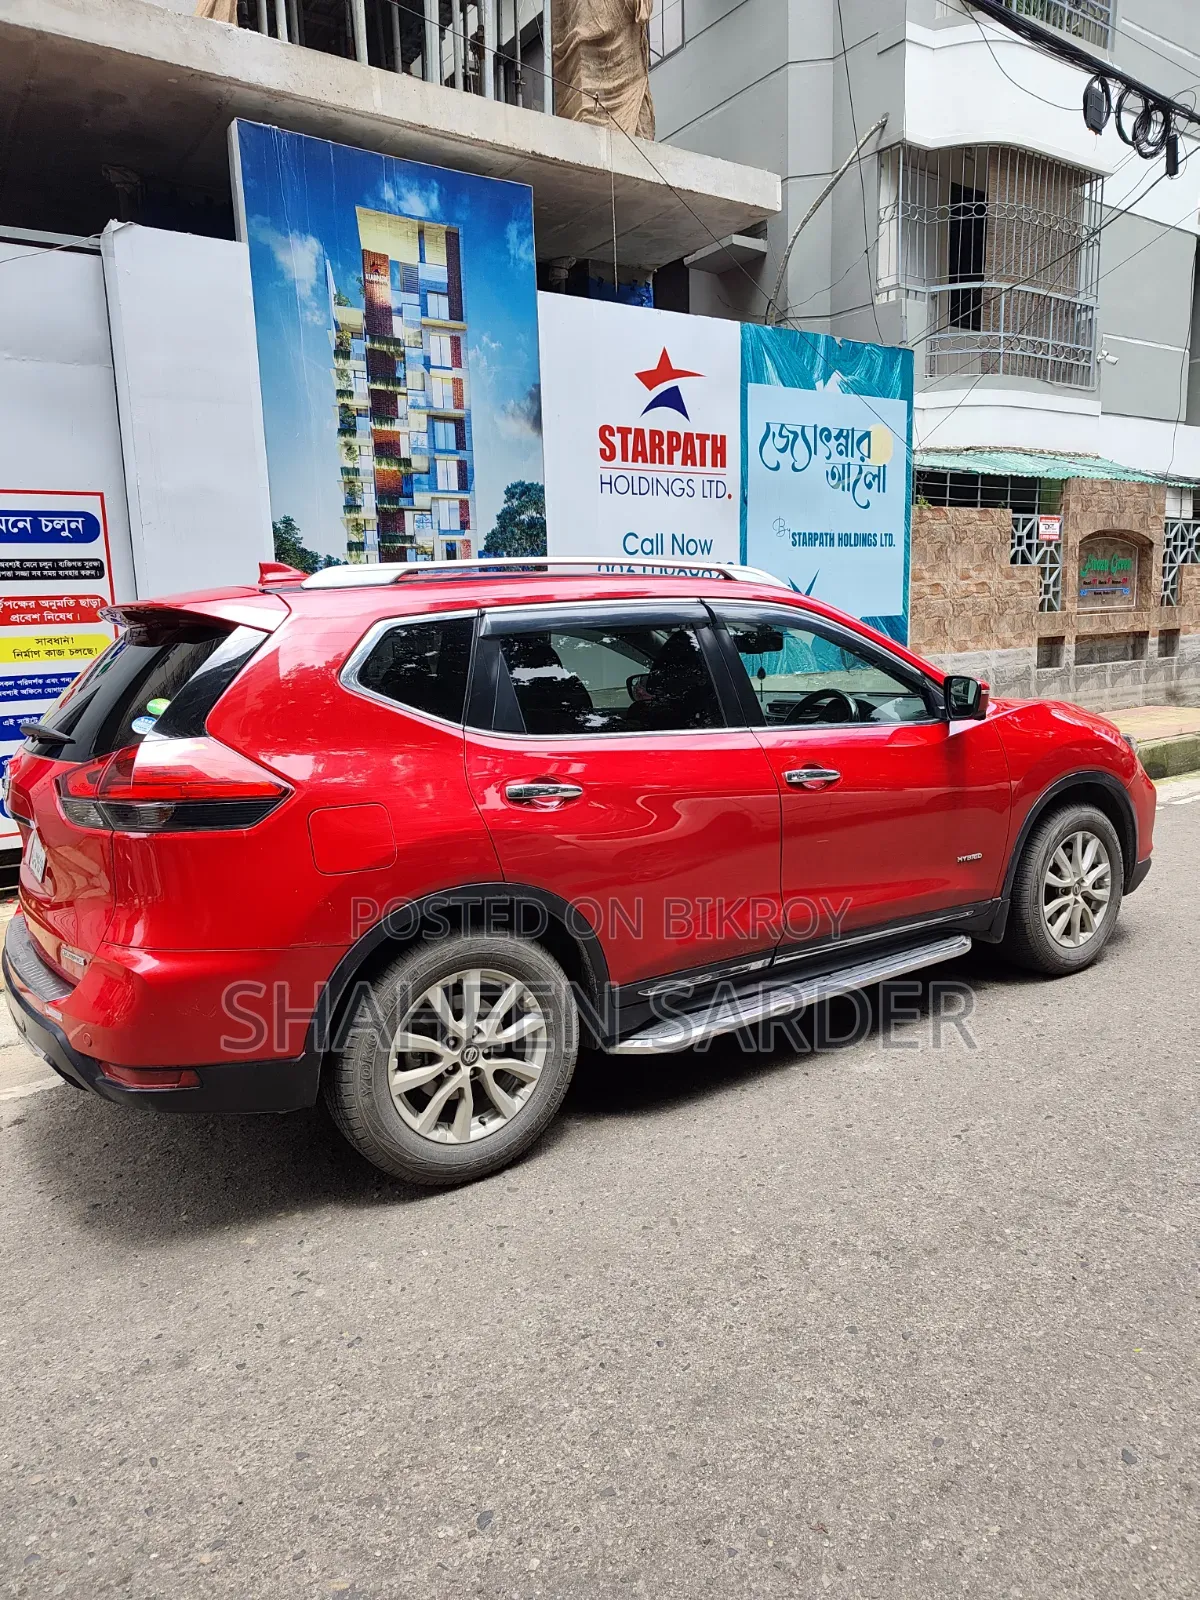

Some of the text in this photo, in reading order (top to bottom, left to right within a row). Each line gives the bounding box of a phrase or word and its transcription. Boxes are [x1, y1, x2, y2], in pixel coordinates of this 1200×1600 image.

[598, 424, 727, 468] STARPATH
[600, 474, 732, 499] HOLDINGS LTD.
[825, 462, 887, 510] আলো
[37, 516, 86, 539] চলুন
[772, 516, 896, 548] By STARPATH HOLDINGS LTD.
[622, 532, 713, 556] Call Now
[39, 596, 77, 610] অনুমতি
[79, 598, 101, 609] ছাড়া
[10, 613, 40, 623] প্রবেশ
[13, 649, 41, 659] নির্মাণ
[43, 649, 66, 657] কাজ
